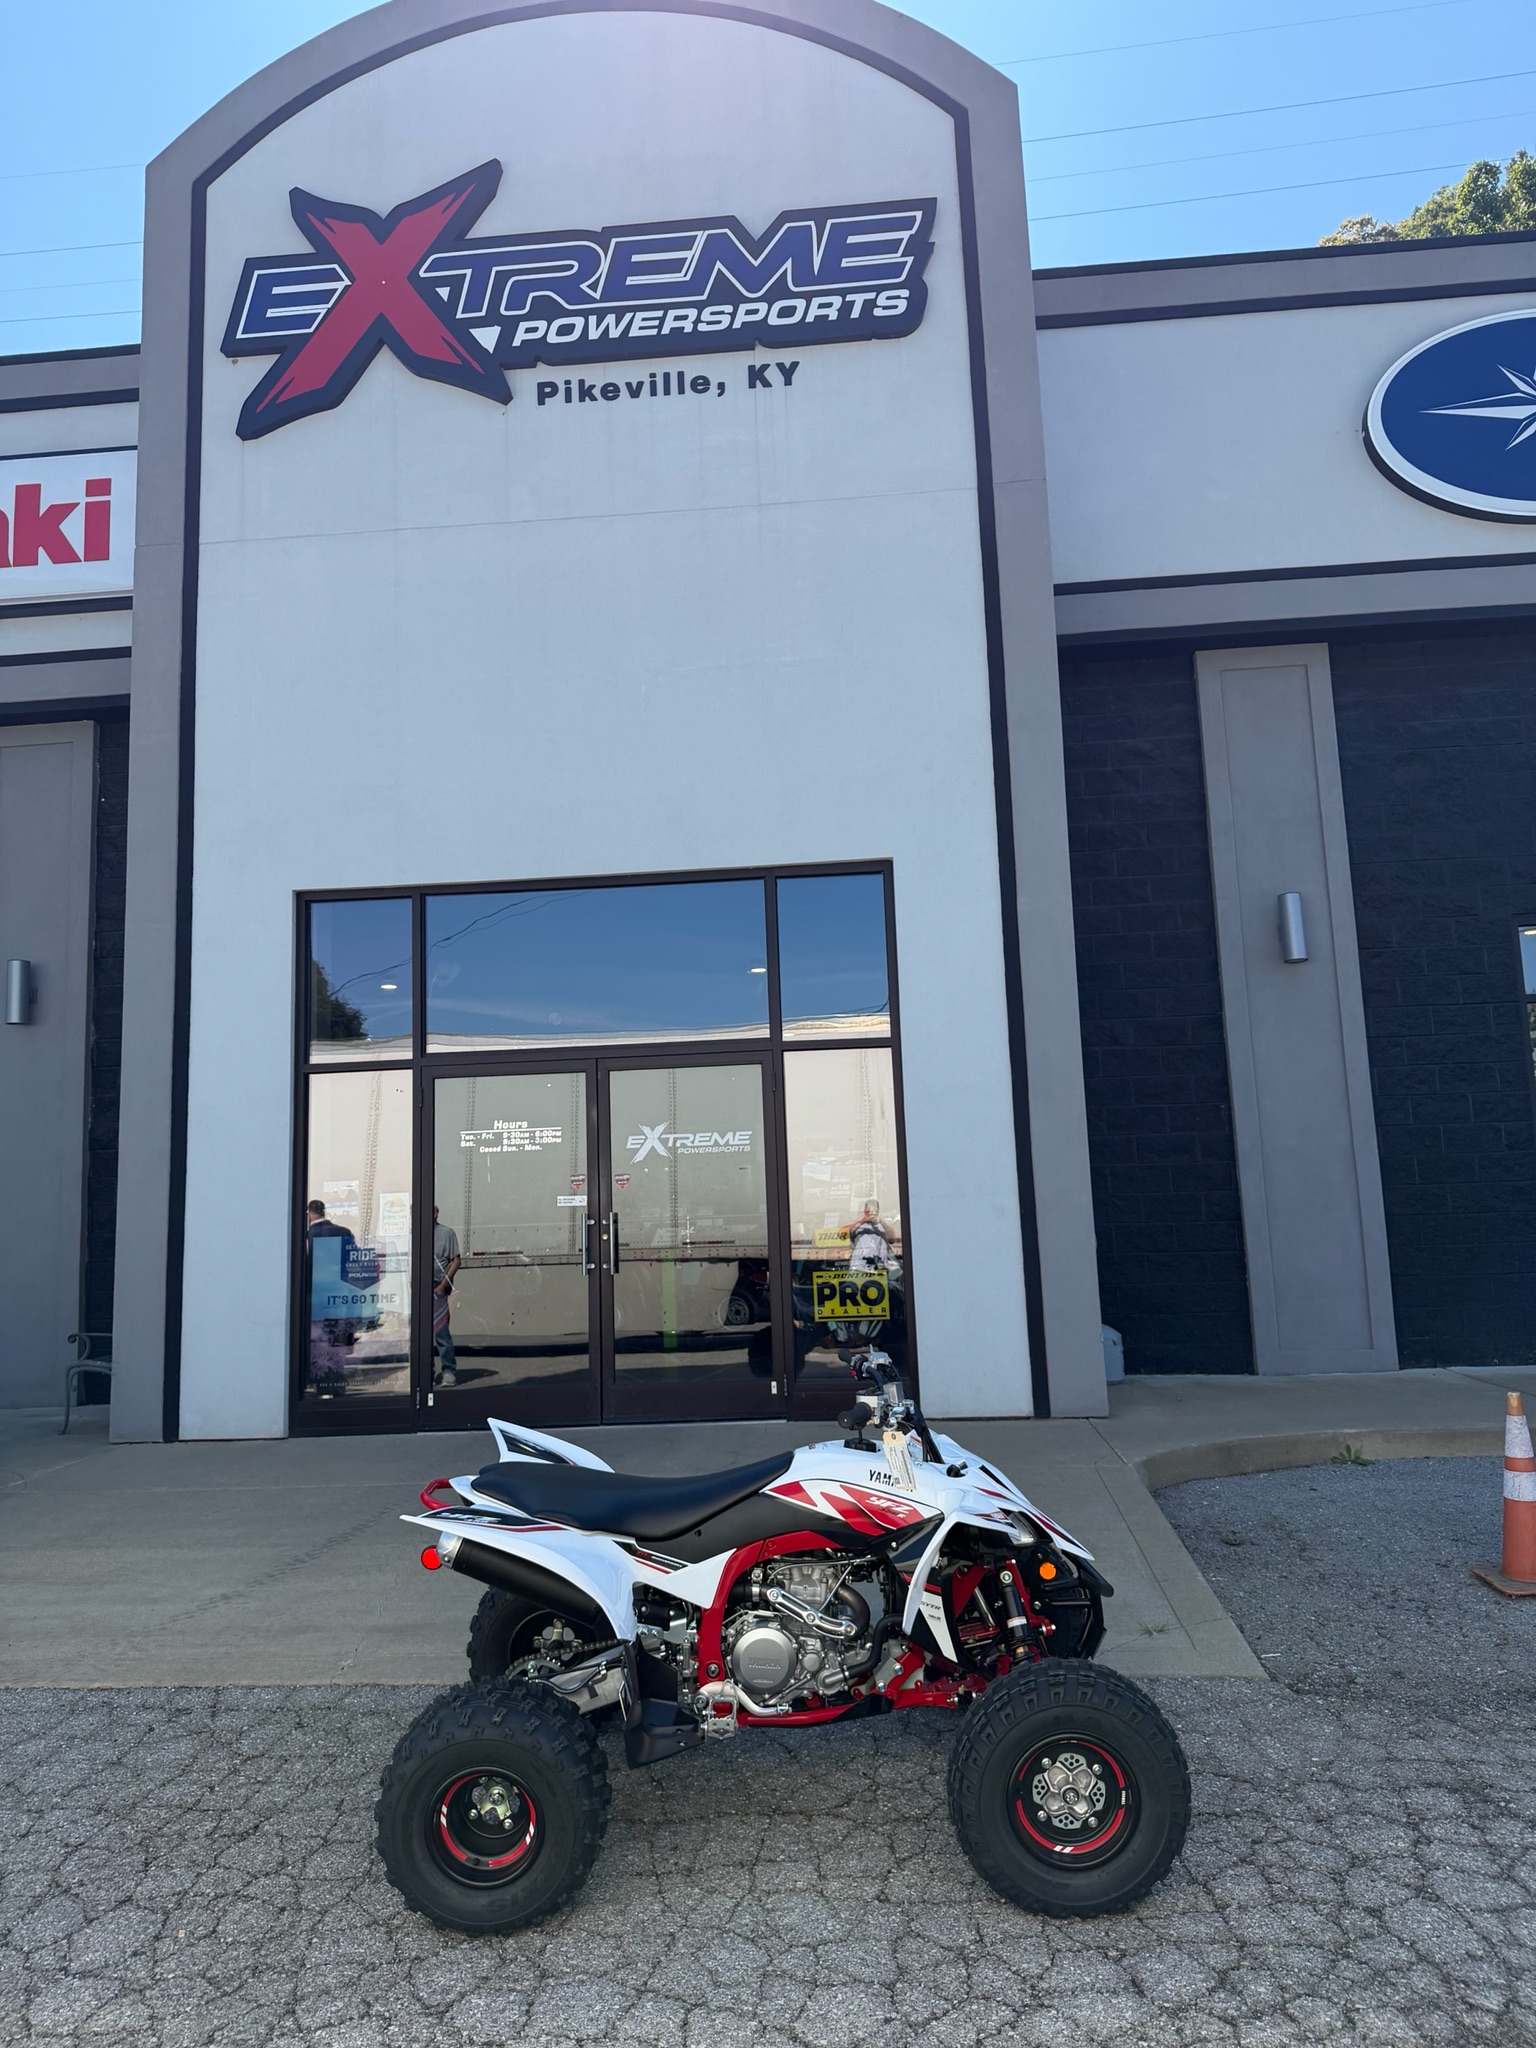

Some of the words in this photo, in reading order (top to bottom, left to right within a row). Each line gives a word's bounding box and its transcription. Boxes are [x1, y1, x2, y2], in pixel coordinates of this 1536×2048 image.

[232, 175, 926, 420] EXTREME
[511, 289, 910, 347] POWERSPORTS
[537, 370, 726, 406] Pikeville,
[747, 361, 800, 389] KY
[493, 1120, 528, 1129] Hours
[626, 1120, 752, 1165] EXTREME
[677, 1145, 751, 1154] POWERSPORTS
[818, 1231, 848, 1241] THOR
[349, 1250, 377, 1262] RIDE
[327, 1295, 349, 1305] IT'S
[351, 1294, 367, 1304] GO
[369, 1293, 397, 1304] TIME
[816, 1280, 886, 1307] PRO
[817, 1307, 887, 1315] DEALER
